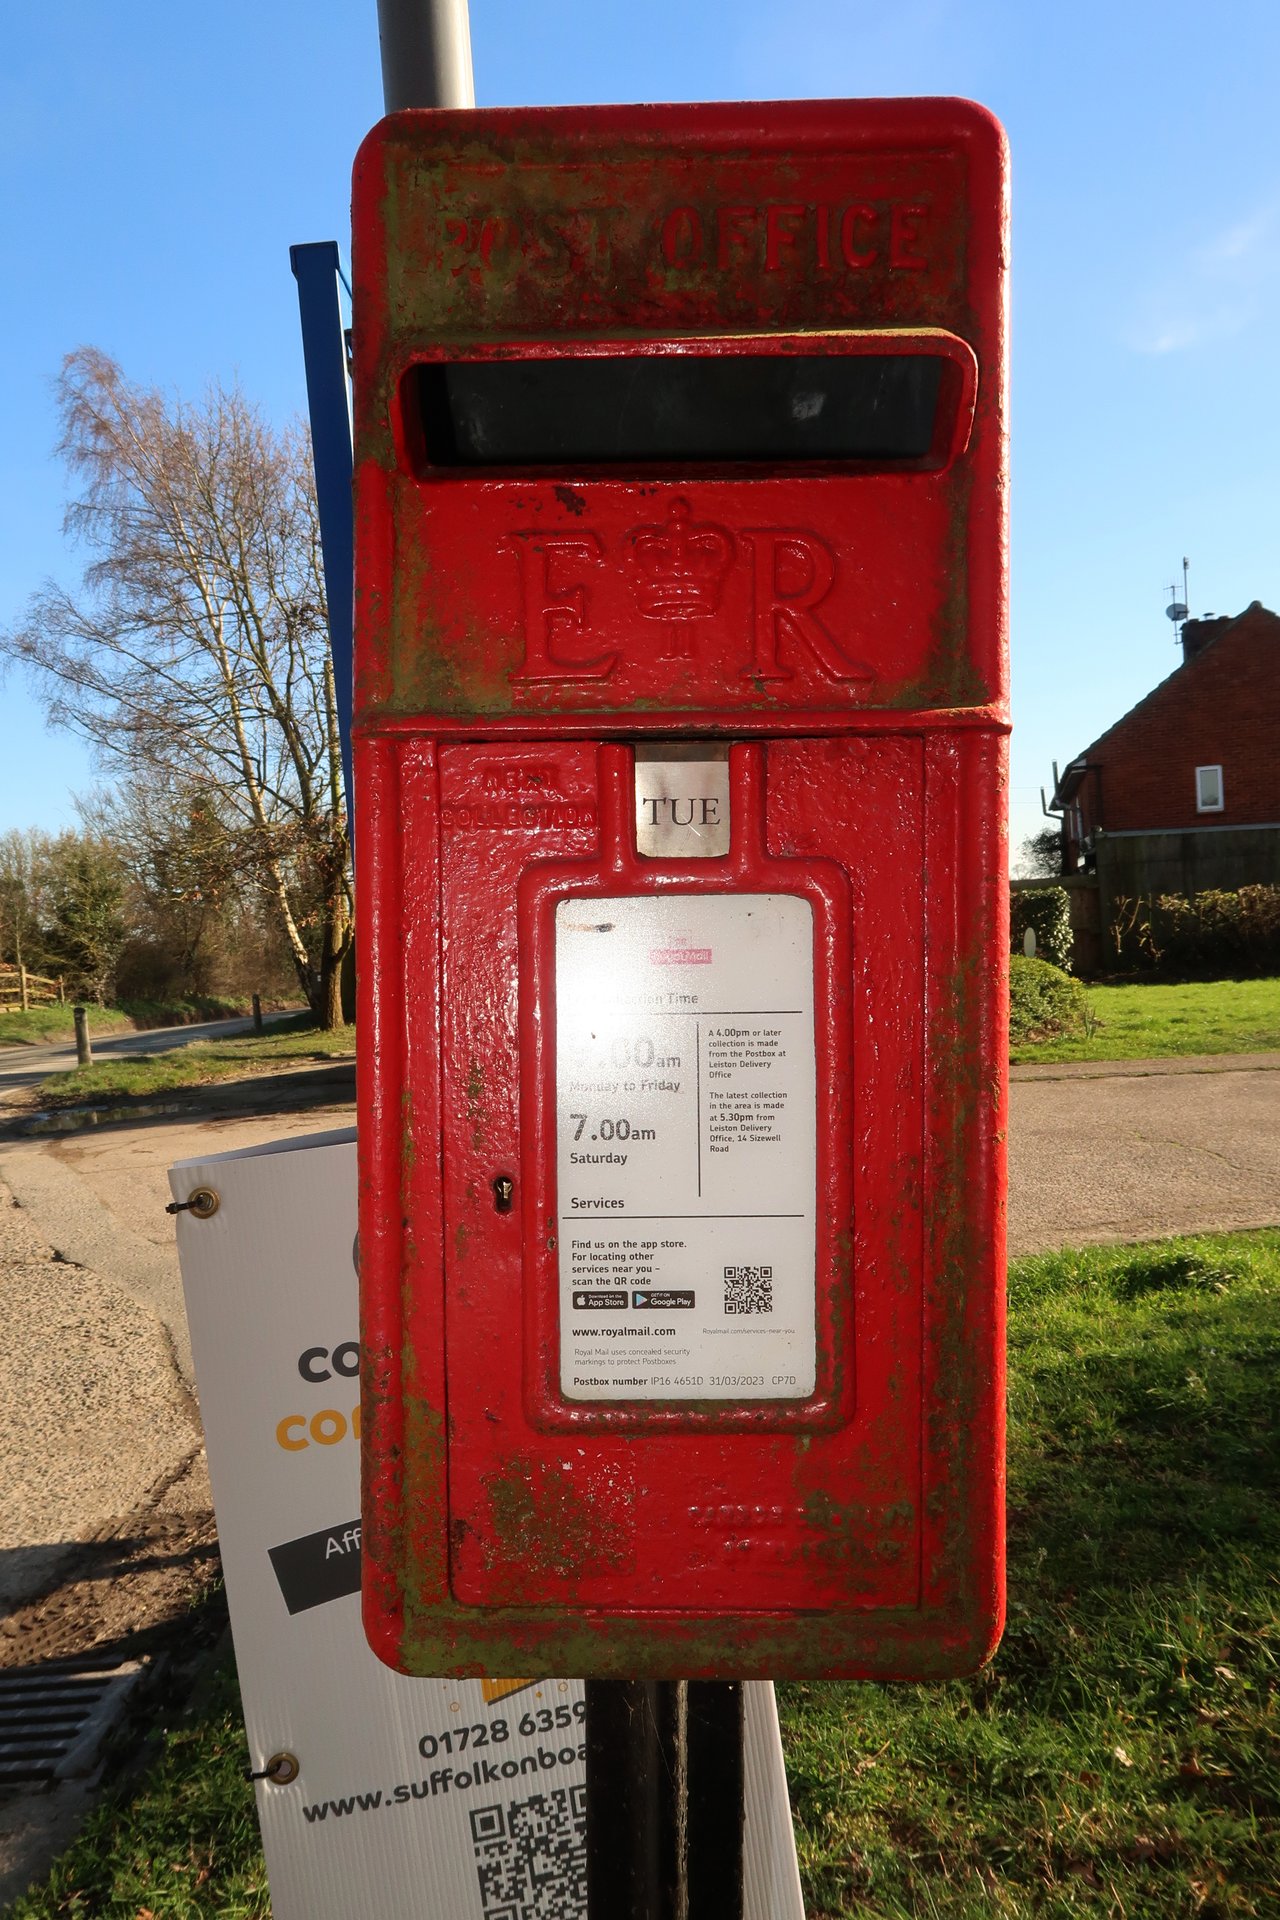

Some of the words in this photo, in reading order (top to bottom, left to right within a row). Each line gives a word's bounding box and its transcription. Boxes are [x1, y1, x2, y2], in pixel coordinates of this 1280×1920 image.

[660, 204, 929, 271] OFFICE
[509, 529, 619, 682] E
[737, 526, 873, 682] R
[643, 797, 721, 827] TUE
[667, 992, 699, 1004] Time
[716, 1028, 750, 1038] 4.00pm
[739, 1060, 771, 1069] Delivery
[569, 1082, 618, 1094] Monday
[623, 1081, 636, 1092] to
[641, 1080, 681, 1093] Friday
[750, 1091, 788, 1099] collection
[720, 1113, 754, 1122] 5.30pm
[569, 1114, 656, 1141] 7.00am
[740, 1124, 772, 1132] Delivery
[749, 1134, 781, 1142] Sizewell
[570, 1152, 628, 1165] Saturday
[571, 1197, 625, 1209] Services
[571, 1240, 591, 1249] Find
[622, 1240, 638, 1248] the
[641, 1241, 658, 1250] app
[660, 1240, 687, 1248] store.
[572, 1253, 587, 1261] For
[590, 1252, 626, 1262] locating
[629, 1252, 654, 1260] other
[572, 1265, 609, 1273] services
[635, 1266, 653, 1274] you
[614, 1277, 627, 1285] QR
[630, 1277, 651, 1285] code
[588, 1299, 604, 1307] App
[604, 1298, 625, 1306] Store
[650, 1297, 676, 1307] Google
[676, 1297, 692, 1306] Play
[572, 1326, 676, 1338] www.royalmail.com
[574, 1348, 593, 1357] Royal
[663, 1348, 690, 1356] security
[616, 1358, 640, 1366] protect
[573, 1377, 610, 1386] Postbox
[612, 1377, 648, 1386] number
[650, 1376, 671, 1386] IP16
[709, 1376, 765, 1386] 31/03/2023
[771, 1376, 796, 1385] CP7D
[418, 1718, 510, 1759] 01728
